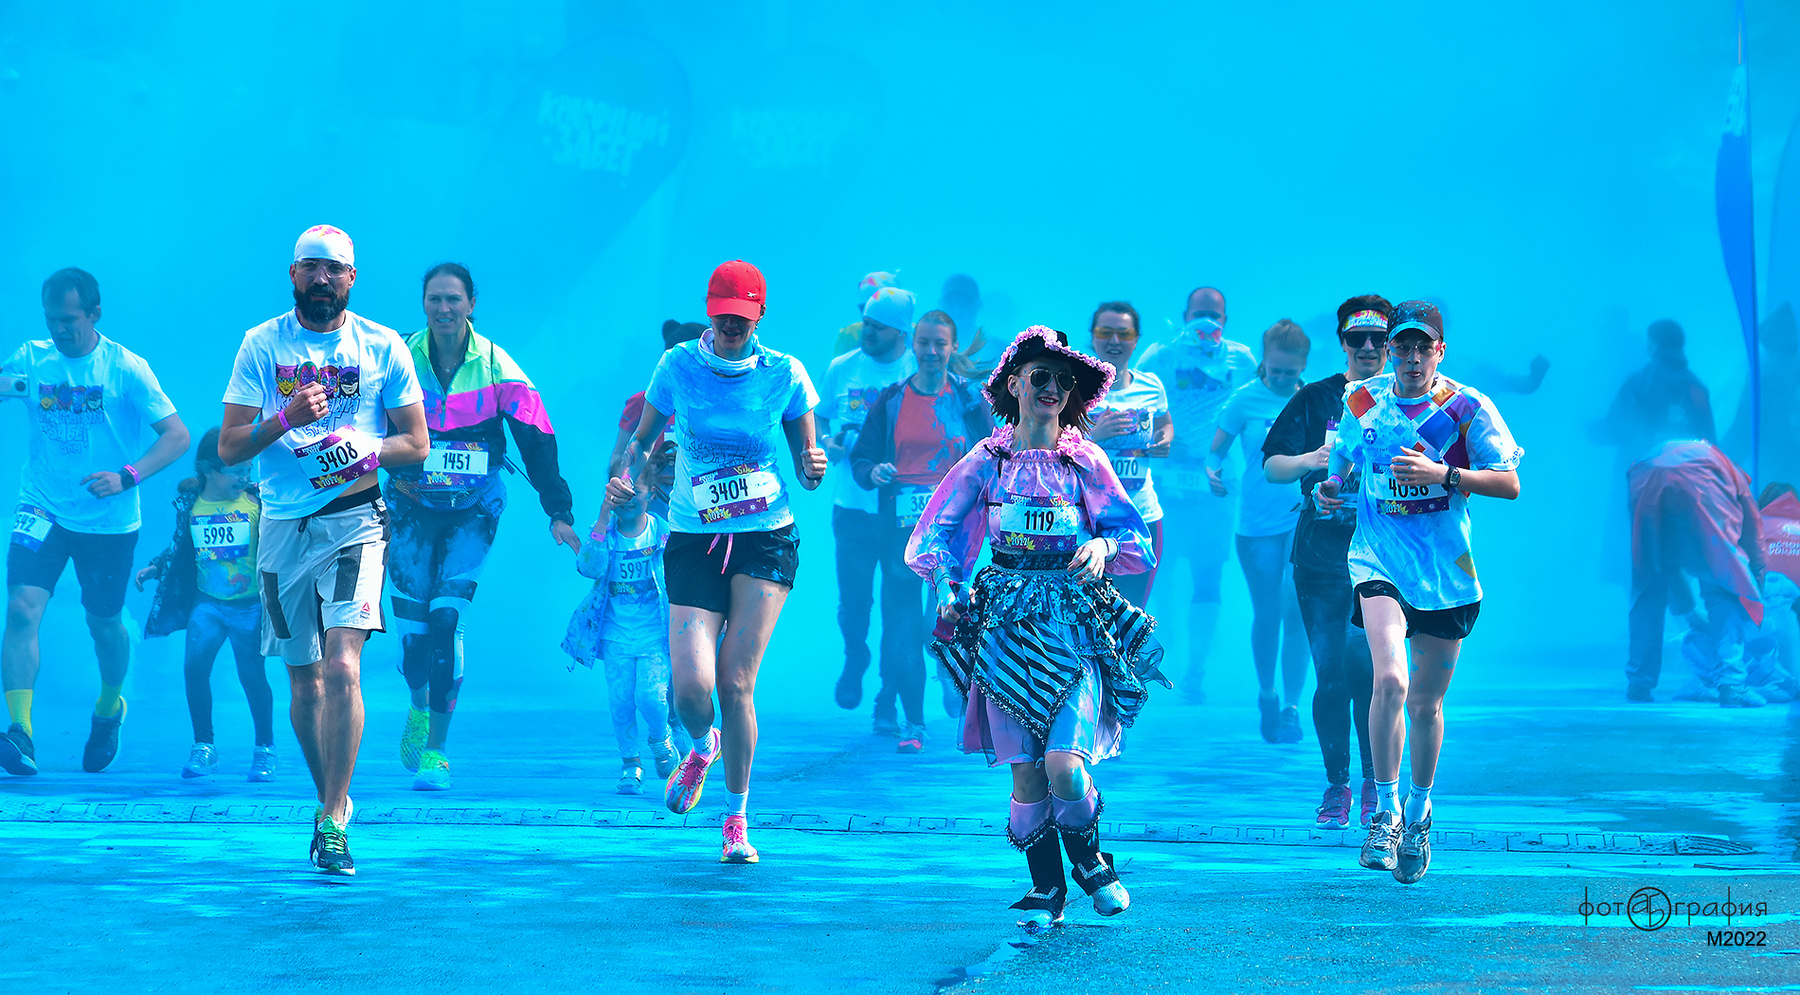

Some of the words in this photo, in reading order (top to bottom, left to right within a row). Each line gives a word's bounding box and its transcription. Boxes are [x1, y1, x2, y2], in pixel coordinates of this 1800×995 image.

[316, 441, 358, 473] 3408
[443, 452, 470, 471] 1451
[1110, 459, 1138, 476] 070
[709, 478, 748, 504] 3404
[1024, 510, 1055, 532] 1119
[203, 526, 235, 545] 5998
[620, 559, 649, 580] 5997
